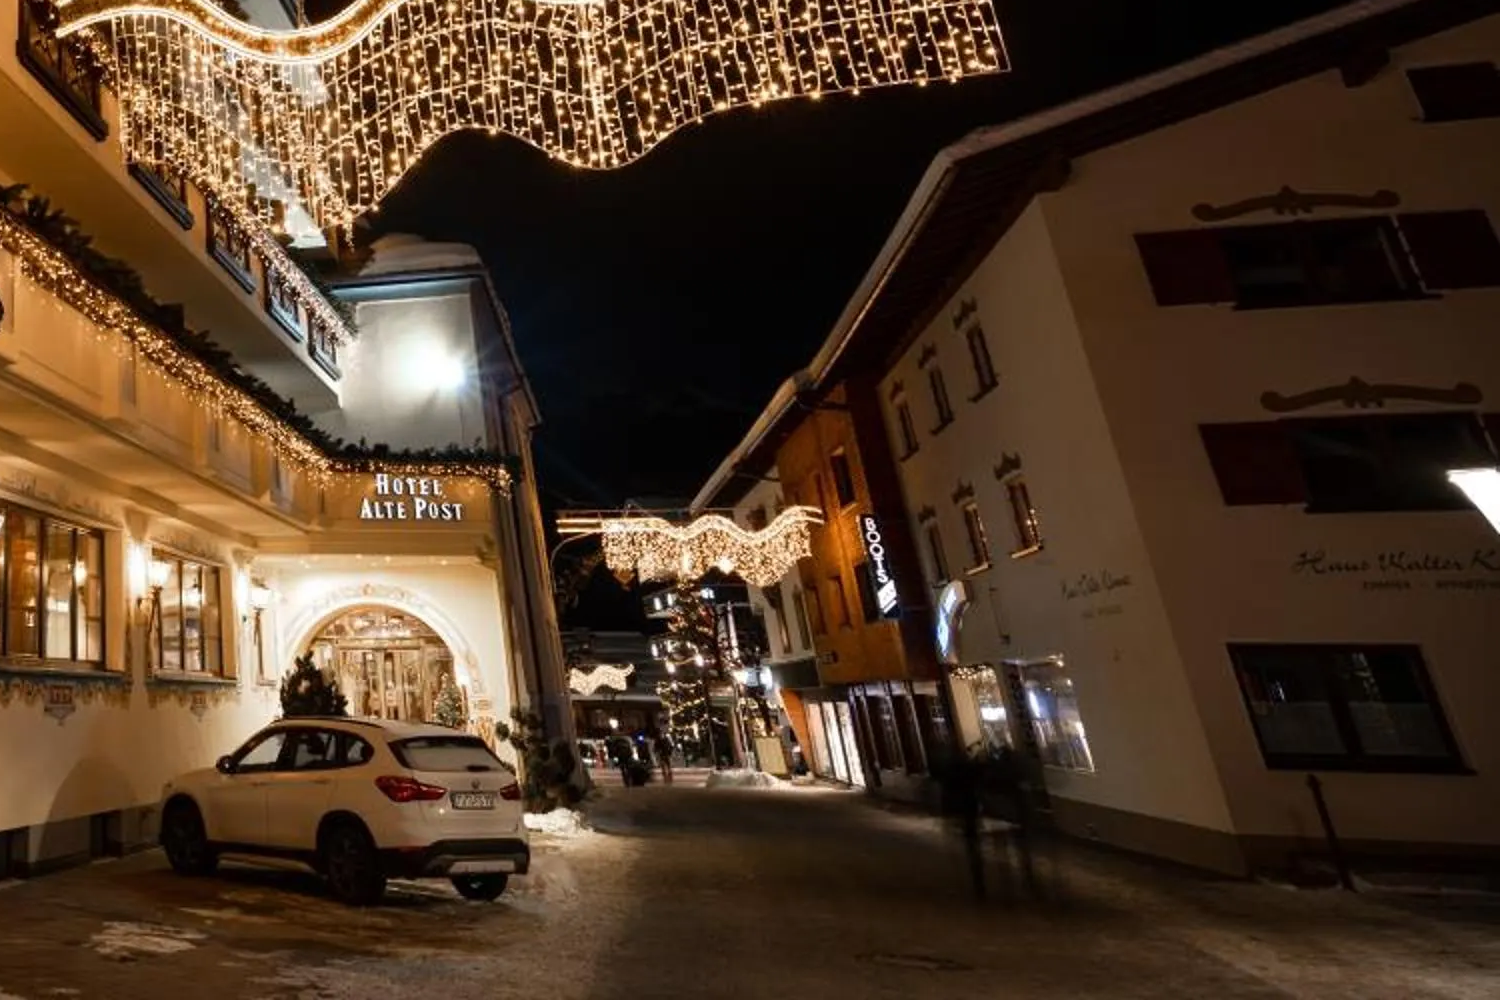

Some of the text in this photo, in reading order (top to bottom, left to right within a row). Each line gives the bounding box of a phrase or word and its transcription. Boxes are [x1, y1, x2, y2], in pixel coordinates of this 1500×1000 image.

[375, 473, 443, 495] HOTEL
[360, 497, 463, 520] ALTE POST
[864, 517, 888, 583] BOOTS
